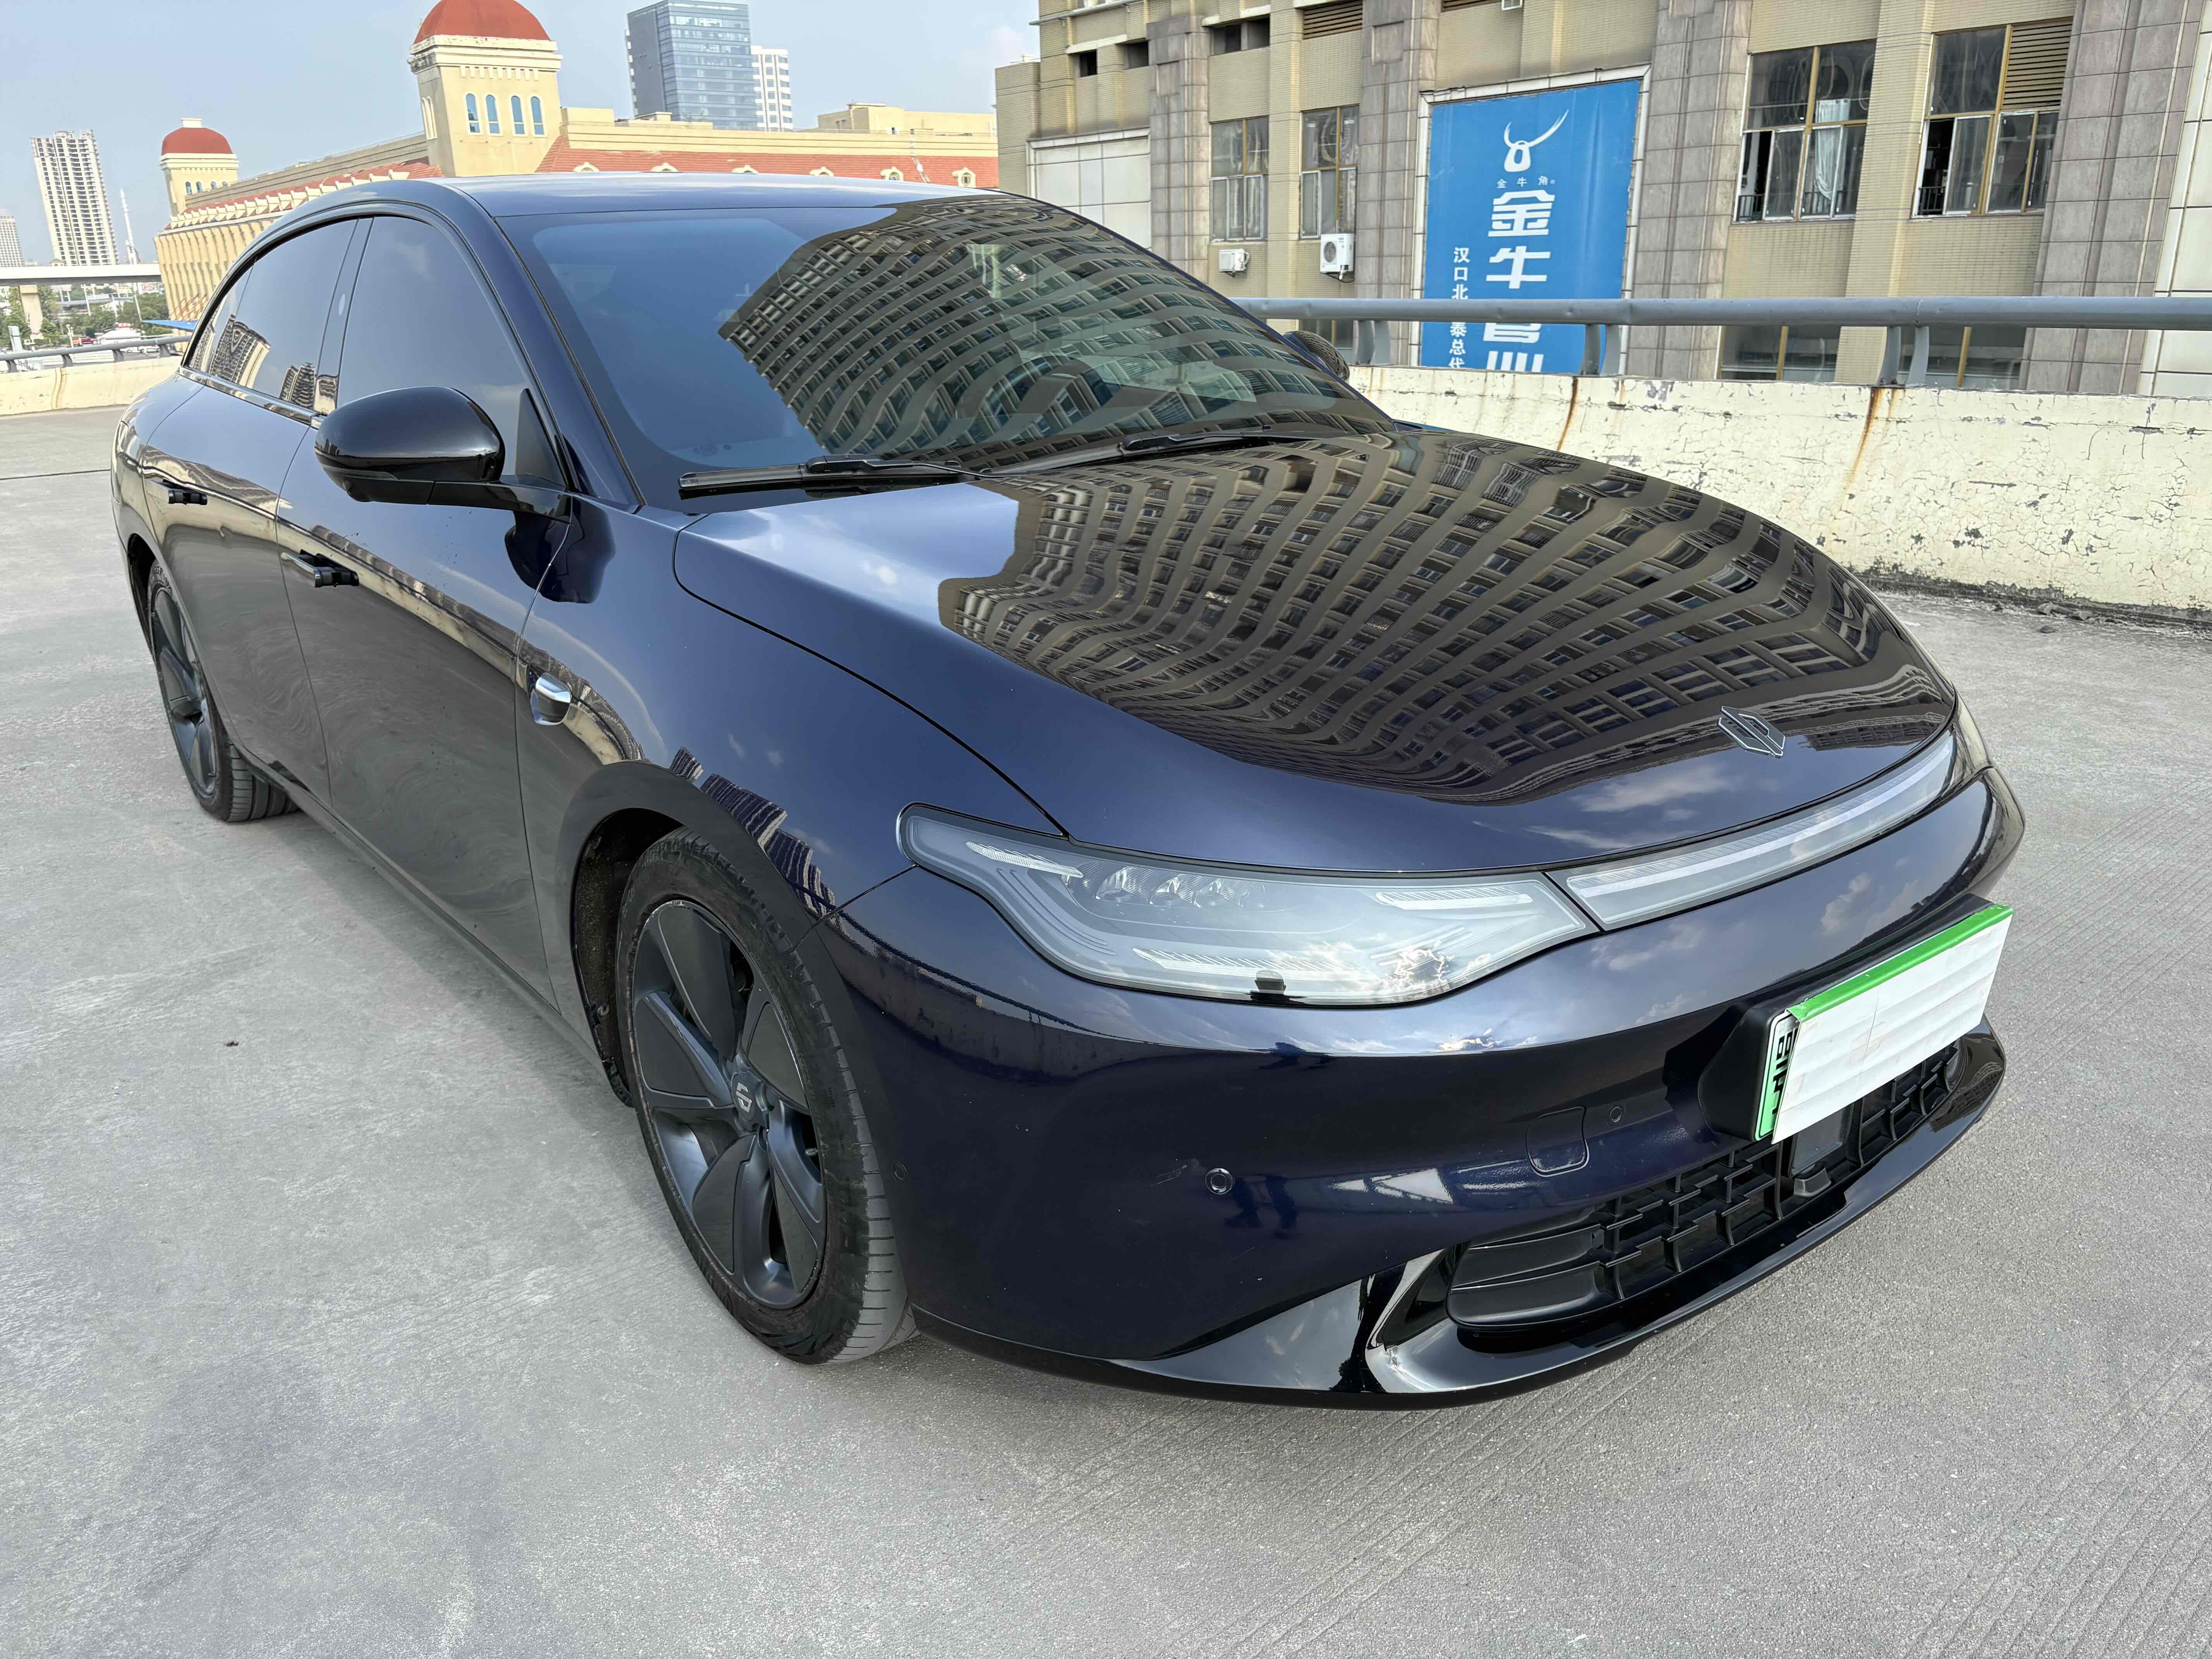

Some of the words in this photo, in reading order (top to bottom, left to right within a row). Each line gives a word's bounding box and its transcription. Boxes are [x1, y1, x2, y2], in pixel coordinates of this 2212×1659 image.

[1496, 175, 1548, 189] 金牛角
[1448, 247, 1470, 368] 汉口北泰总代
